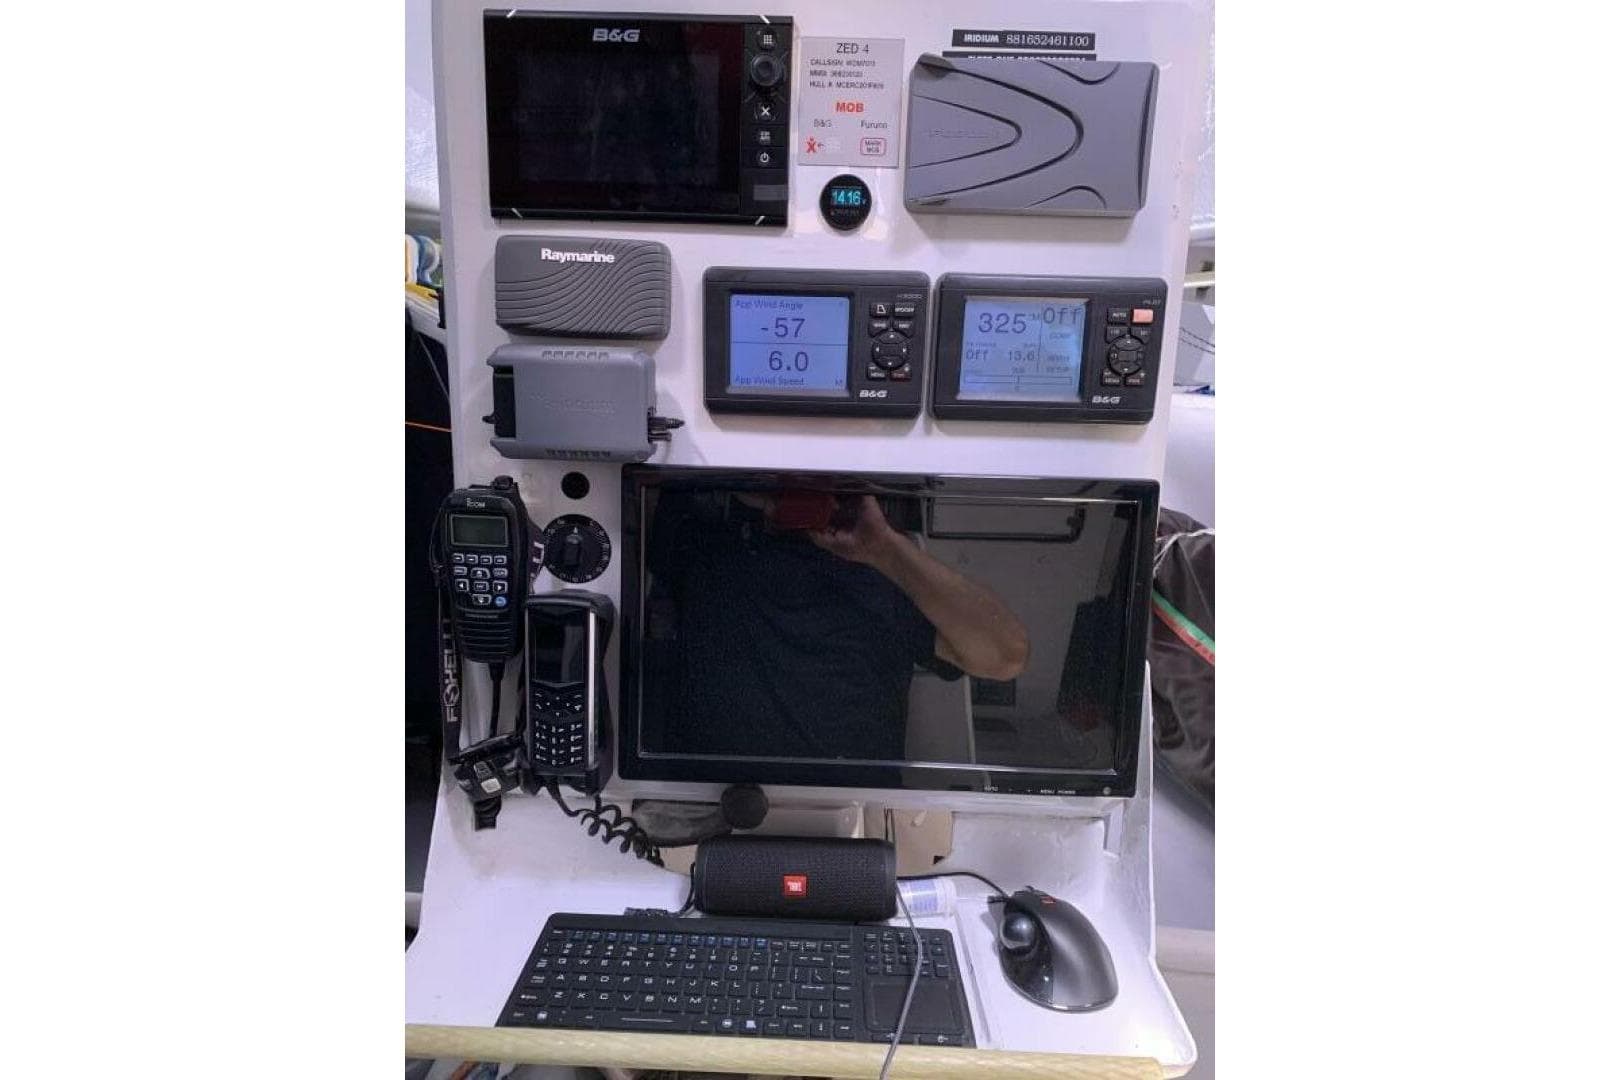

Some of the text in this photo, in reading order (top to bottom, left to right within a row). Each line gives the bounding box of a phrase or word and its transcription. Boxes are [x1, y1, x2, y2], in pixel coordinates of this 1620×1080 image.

[593, 28, 640, 42] B&G
[964, 33, 999, 43] IRIDIUM
[836, 43, 870, 54] ZED 4
[836, 102, 865, 112] MOB
[860, 120, 888, 129] Furuno
[541, 248, 615, 263] Raymarine
[1043, 307, 1082, 325] Off
[978, 313, 1027, 333] 325
[768, 351, 809, 371] 6.0
[859, 389, 888, 398] B&G
[1092, 396, 1121, 404] B&G
